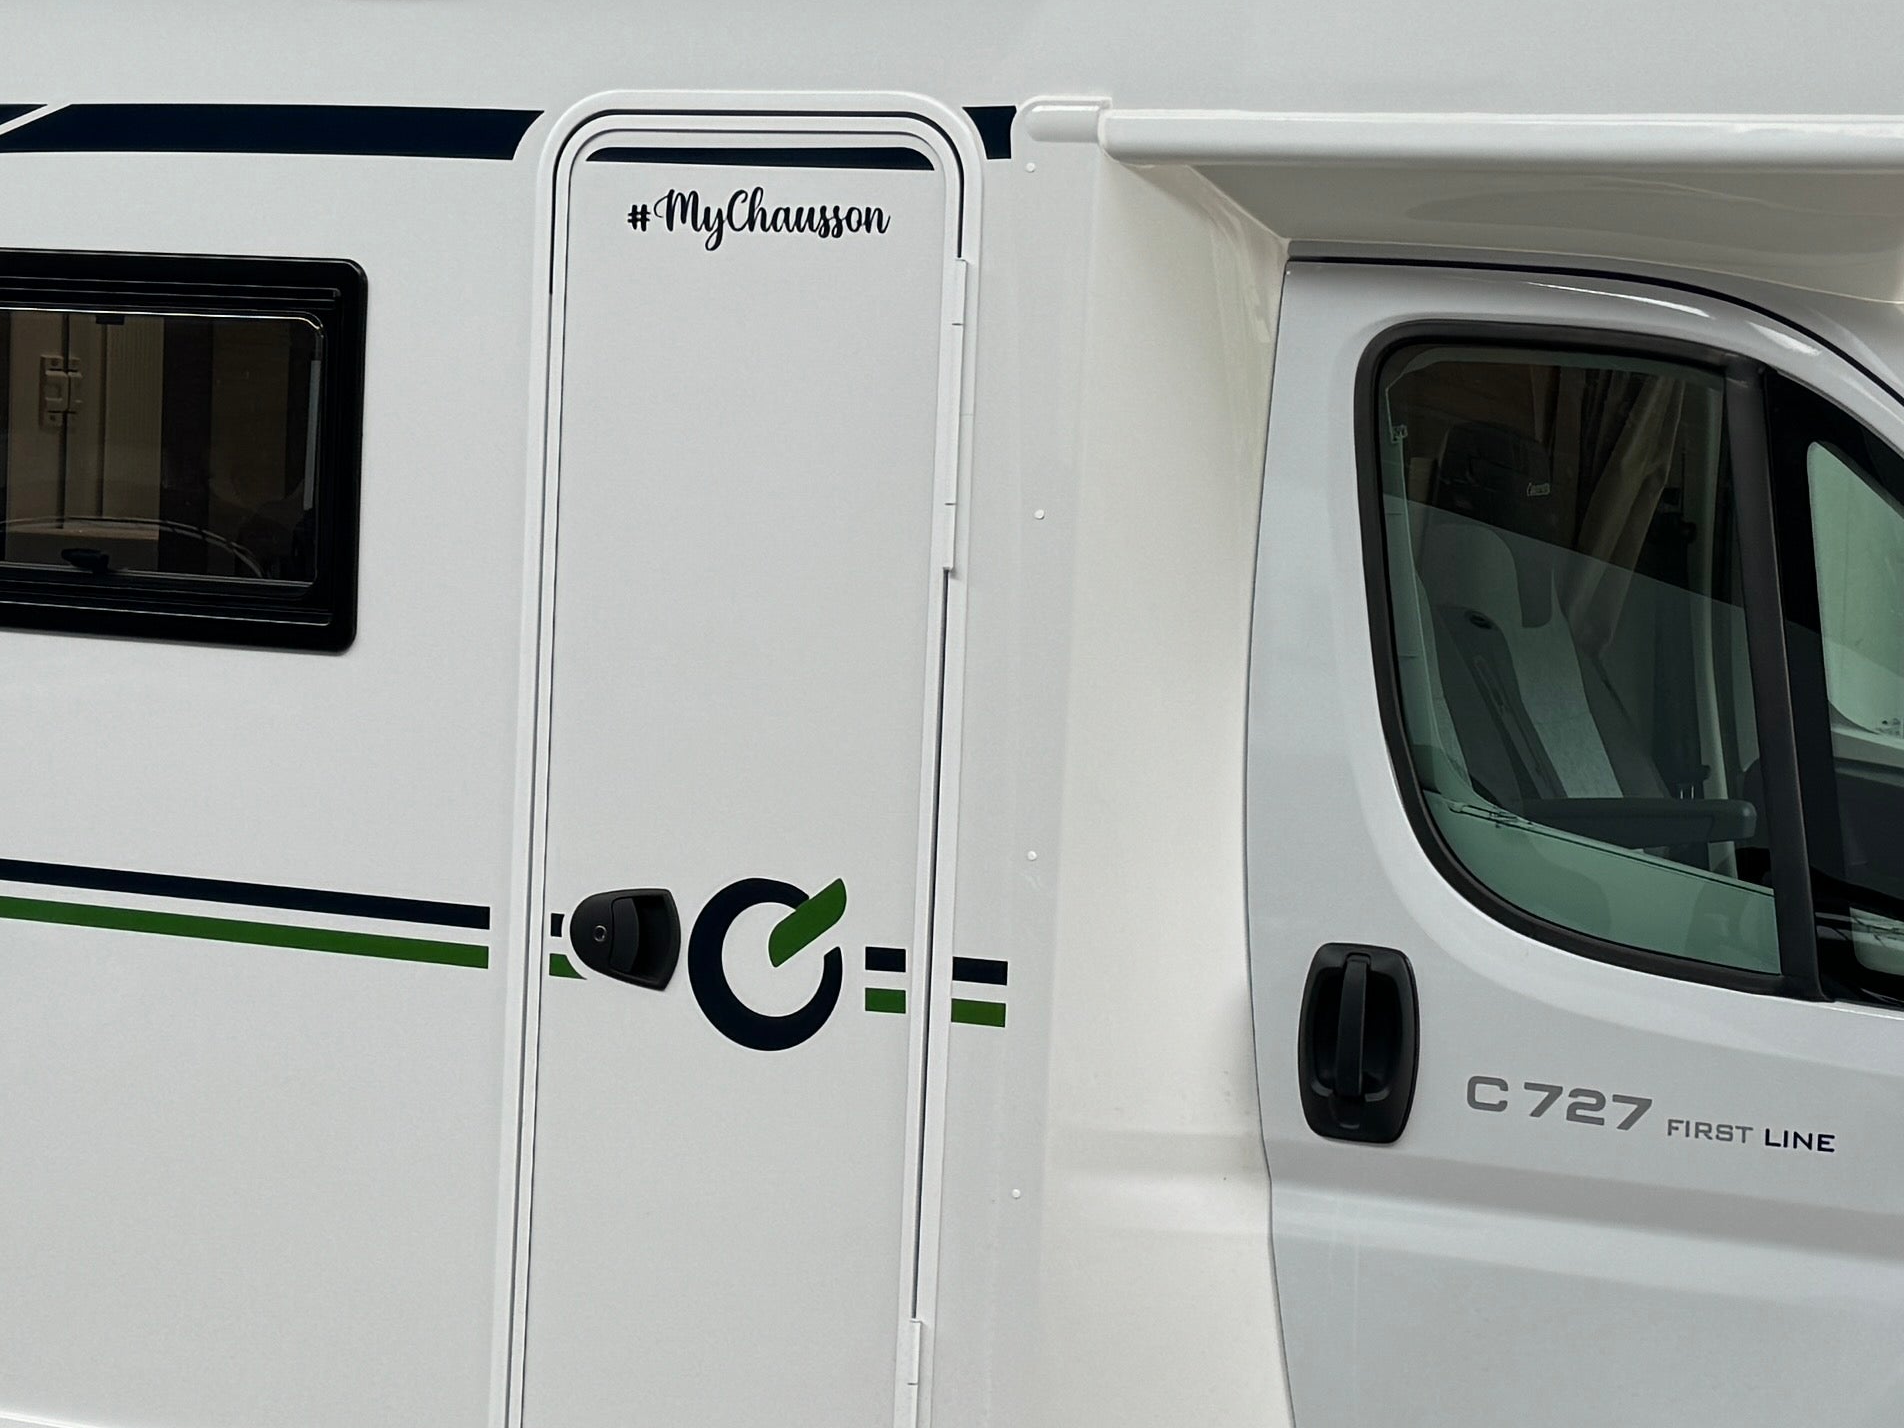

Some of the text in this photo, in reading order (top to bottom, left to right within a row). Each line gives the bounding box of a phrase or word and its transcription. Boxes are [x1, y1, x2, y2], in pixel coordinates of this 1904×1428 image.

[627, 187, 891, 252] #MyChausson
[1467, 1075, 1836, 1153] C 727 FIRST LINE
